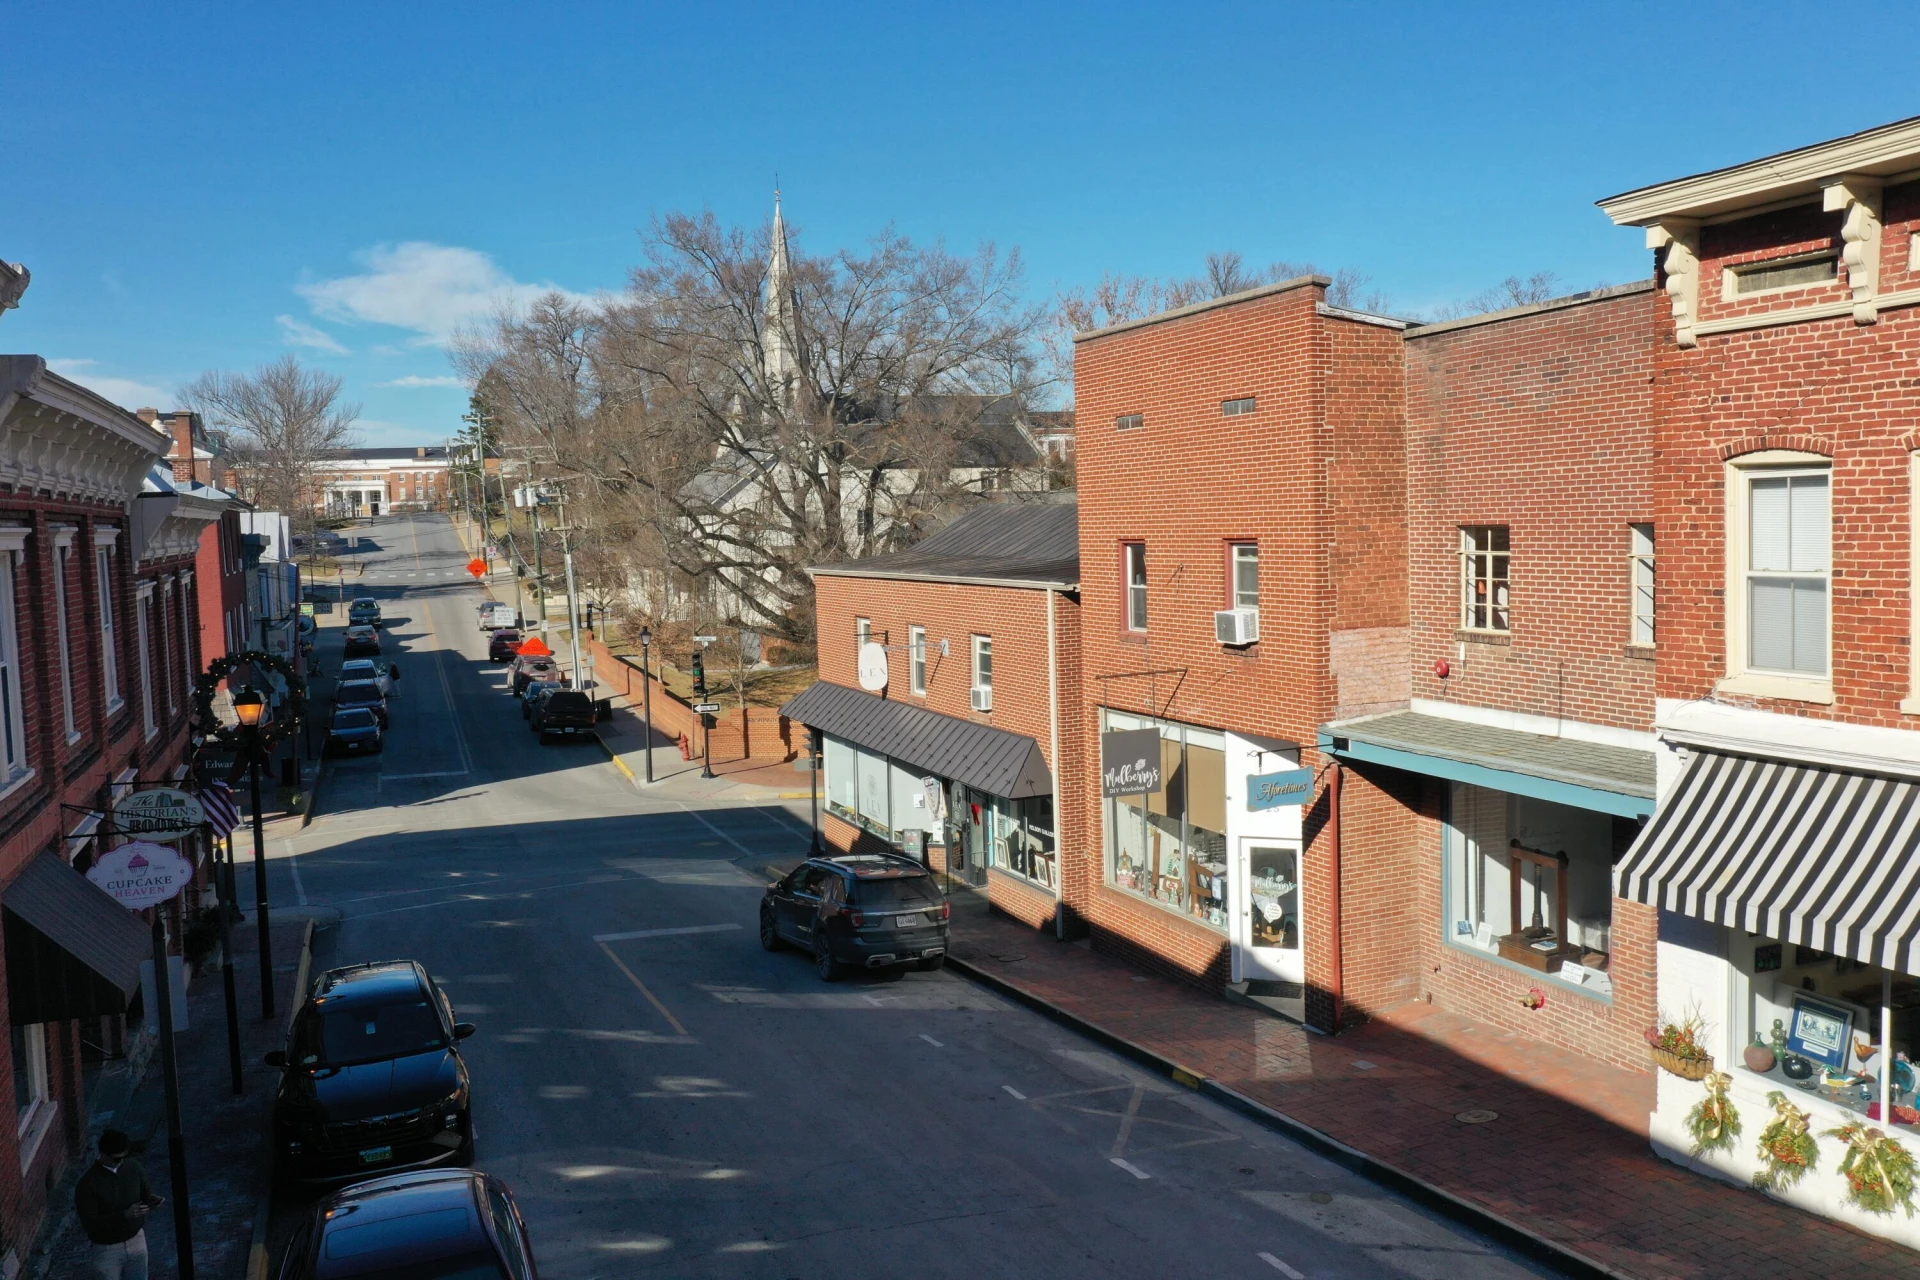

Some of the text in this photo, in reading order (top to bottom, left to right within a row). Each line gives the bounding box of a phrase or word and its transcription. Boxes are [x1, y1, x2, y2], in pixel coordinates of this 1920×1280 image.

[205, 759, 234, 769] Edwar
[1104, 764, 1160, 788] Mulberry's
[1121, 785, 1146, 793] Workshop
[1256, 781, 1308, 802] Aforetimes
[132, 794, 154, 806] The
[120, 806, 197, 820] HISTORIAN'S
[129, 816, 191, 833] BOOKS
[107, 875, 173, 890] CUPCAKE
[115, 886, 165, 898] HEAVEN
